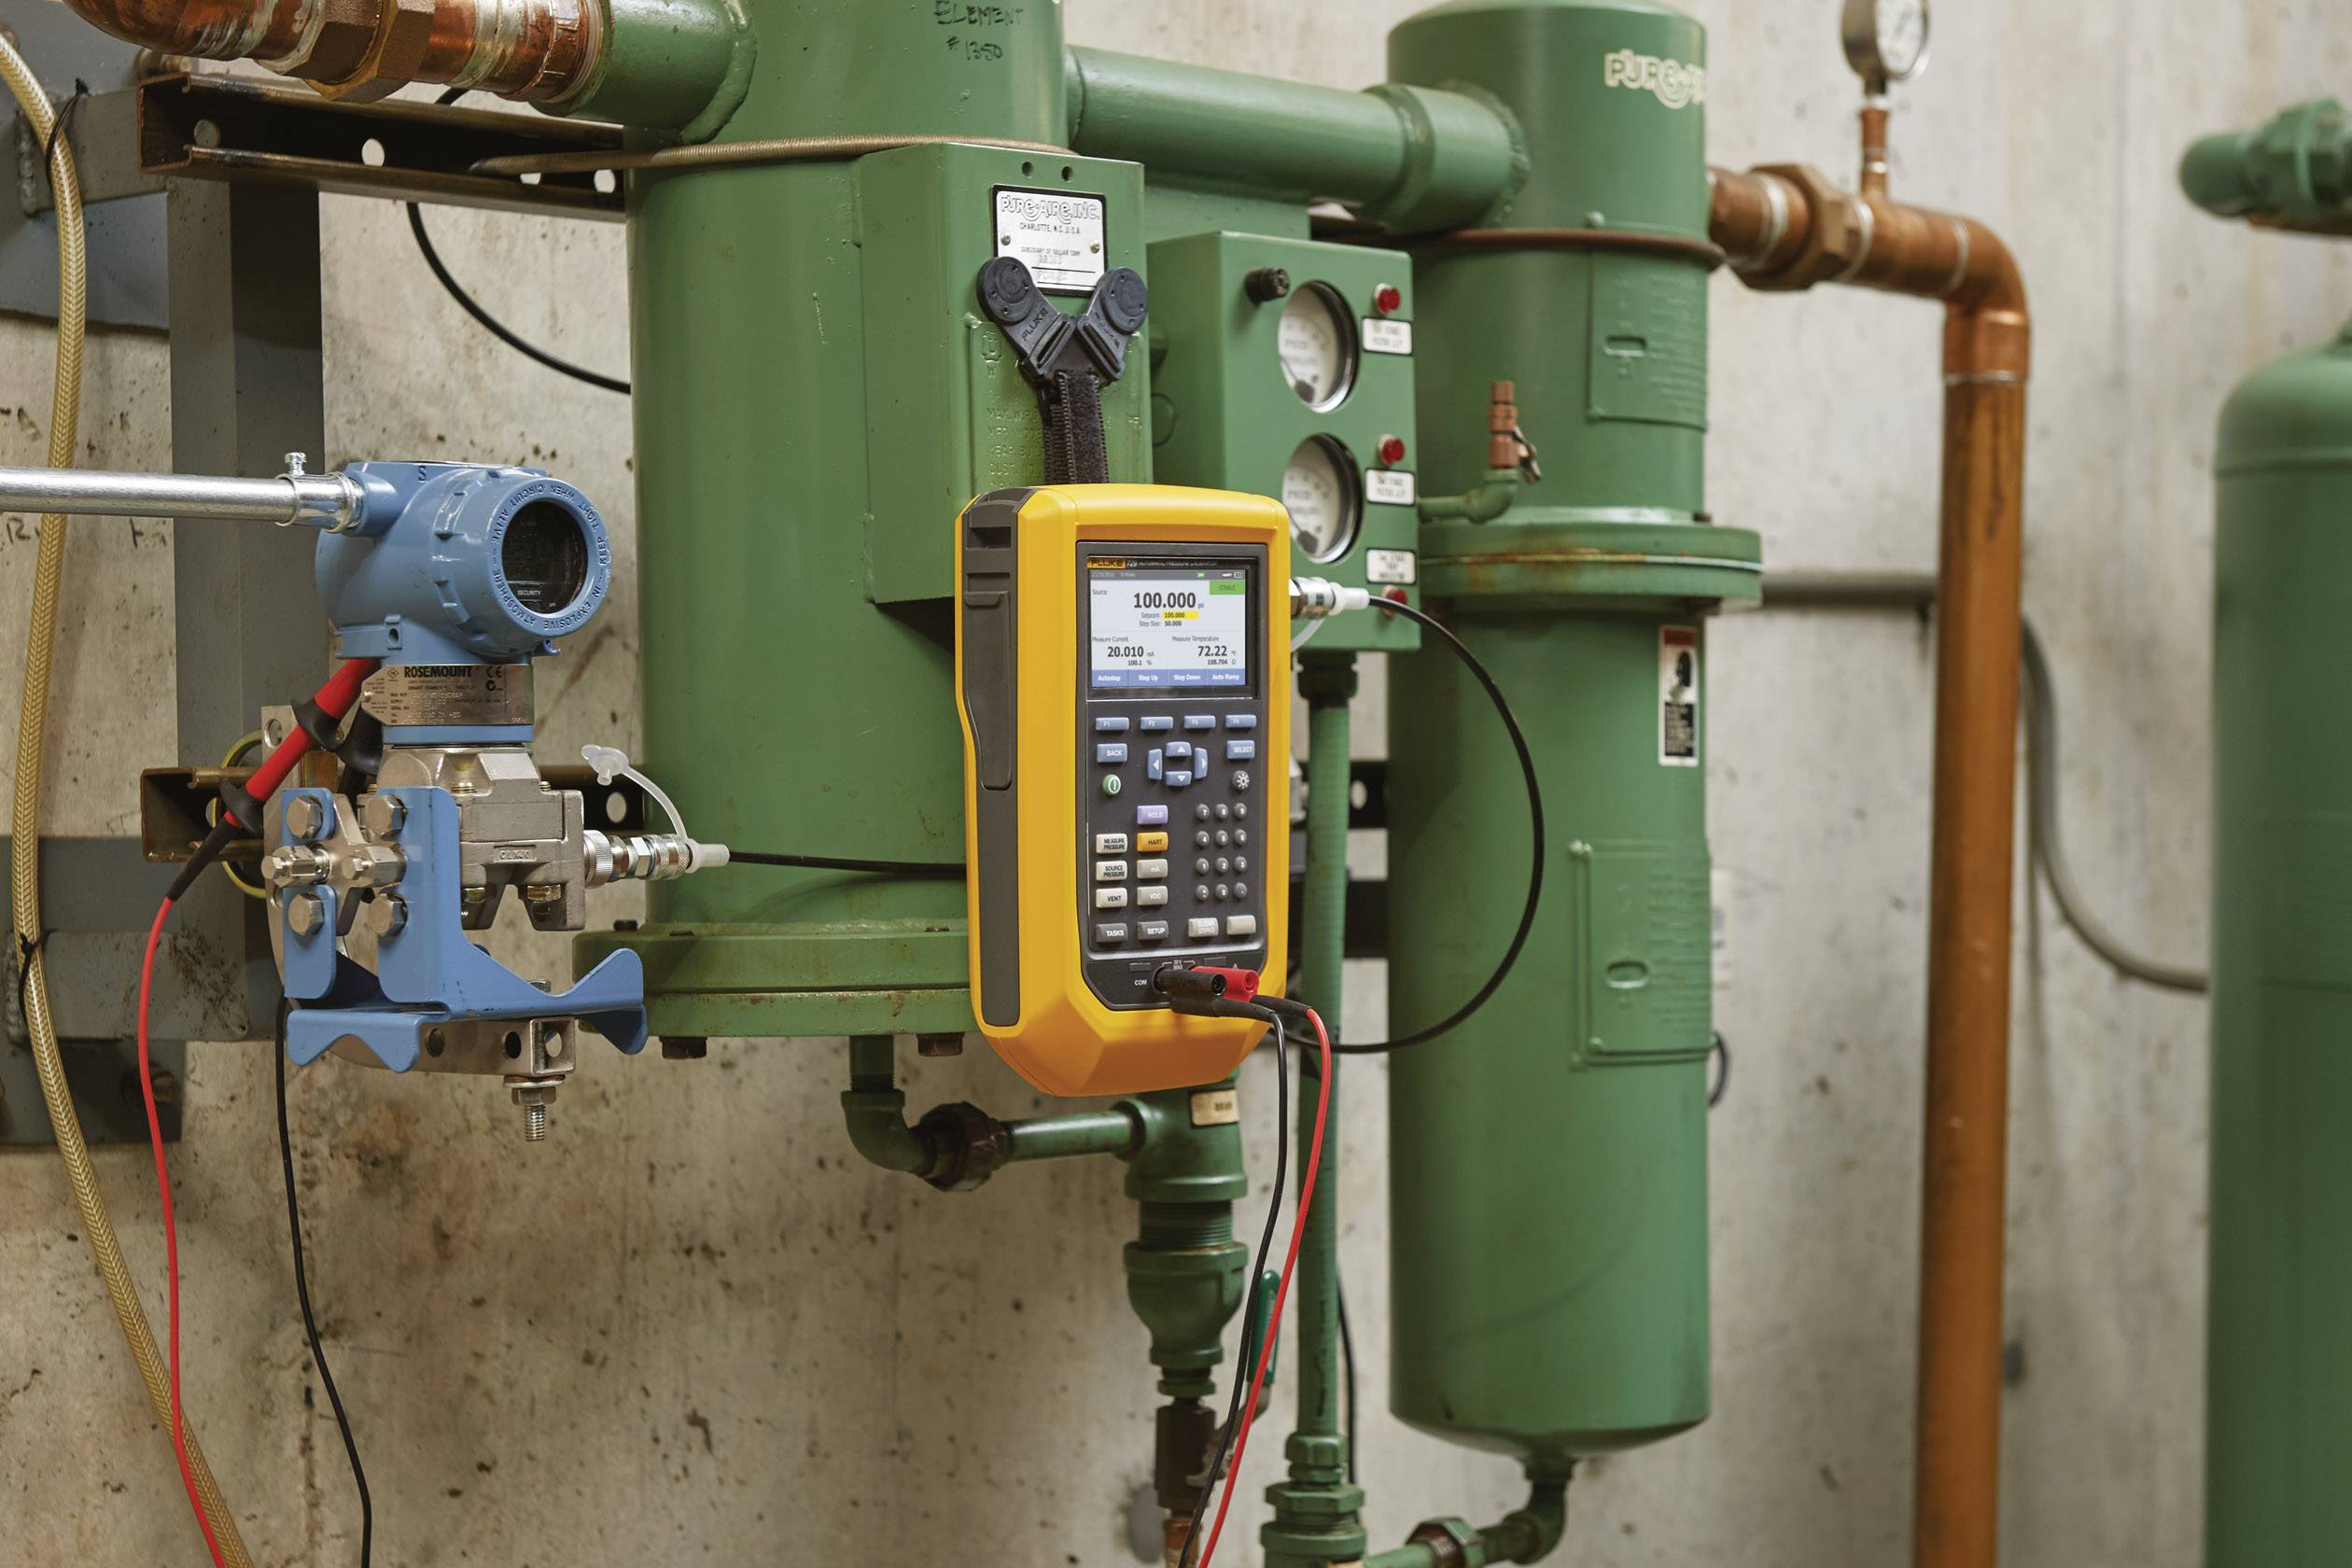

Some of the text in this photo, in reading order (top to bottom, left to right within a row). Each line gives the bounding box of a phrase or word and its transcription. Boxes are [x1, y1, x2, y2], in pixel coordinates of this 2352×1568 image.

[1021, 307, 1049, 343] FLUKE
[596, 537, 607, 566] KEEP
[1134, 592, 1197, 609] 100.000
[1107, 646, 1144, 657] 20.010
[1197, 645, 1227, 656] 72.22
[404, 666, 471, 678] ROSEMOUNT
